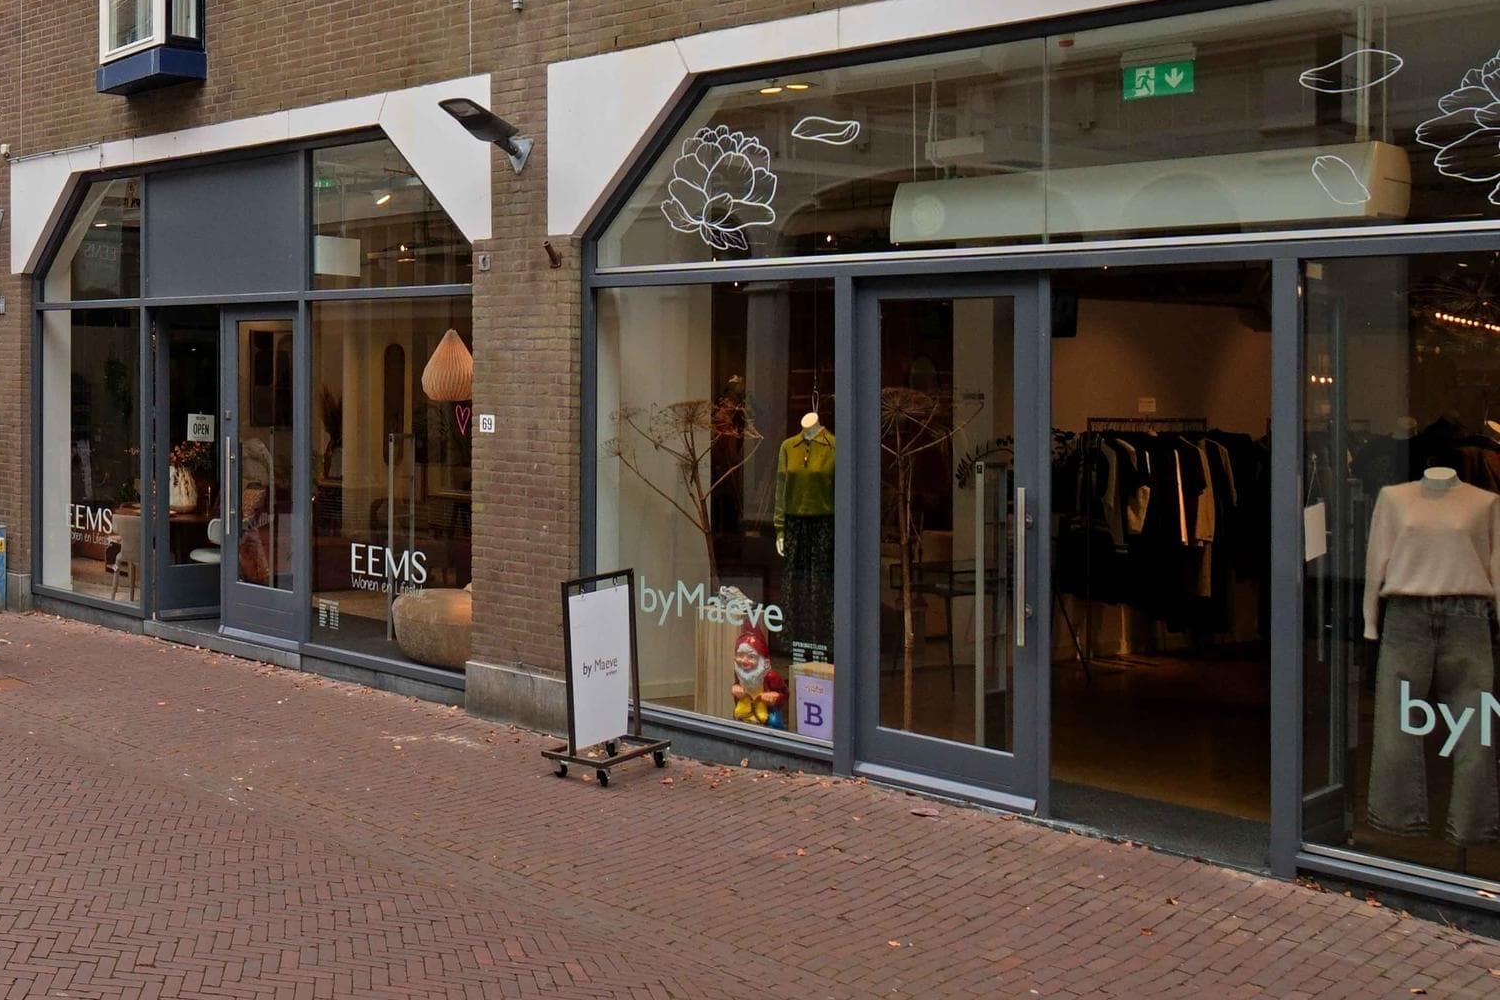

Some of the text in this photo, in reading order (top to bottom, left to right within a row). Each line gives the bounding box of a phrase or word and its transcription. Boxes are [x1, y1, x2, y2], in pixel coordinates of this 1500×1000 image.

[193, 423, 210, 435] OPEN
[482, 417, 493, 430] 69
[67, 504, 113, 534] EEMS
[351, 543, 427, 584] EEMS
[351, 574, 378, 592] Wonen
[381, 582, 392, 593] en
[640, 575, 784, 633] byMaeve
[582, 661, 592, 678] by
[594, 657, 618, 672] Maeve
[803, 701, 824, 726] B
